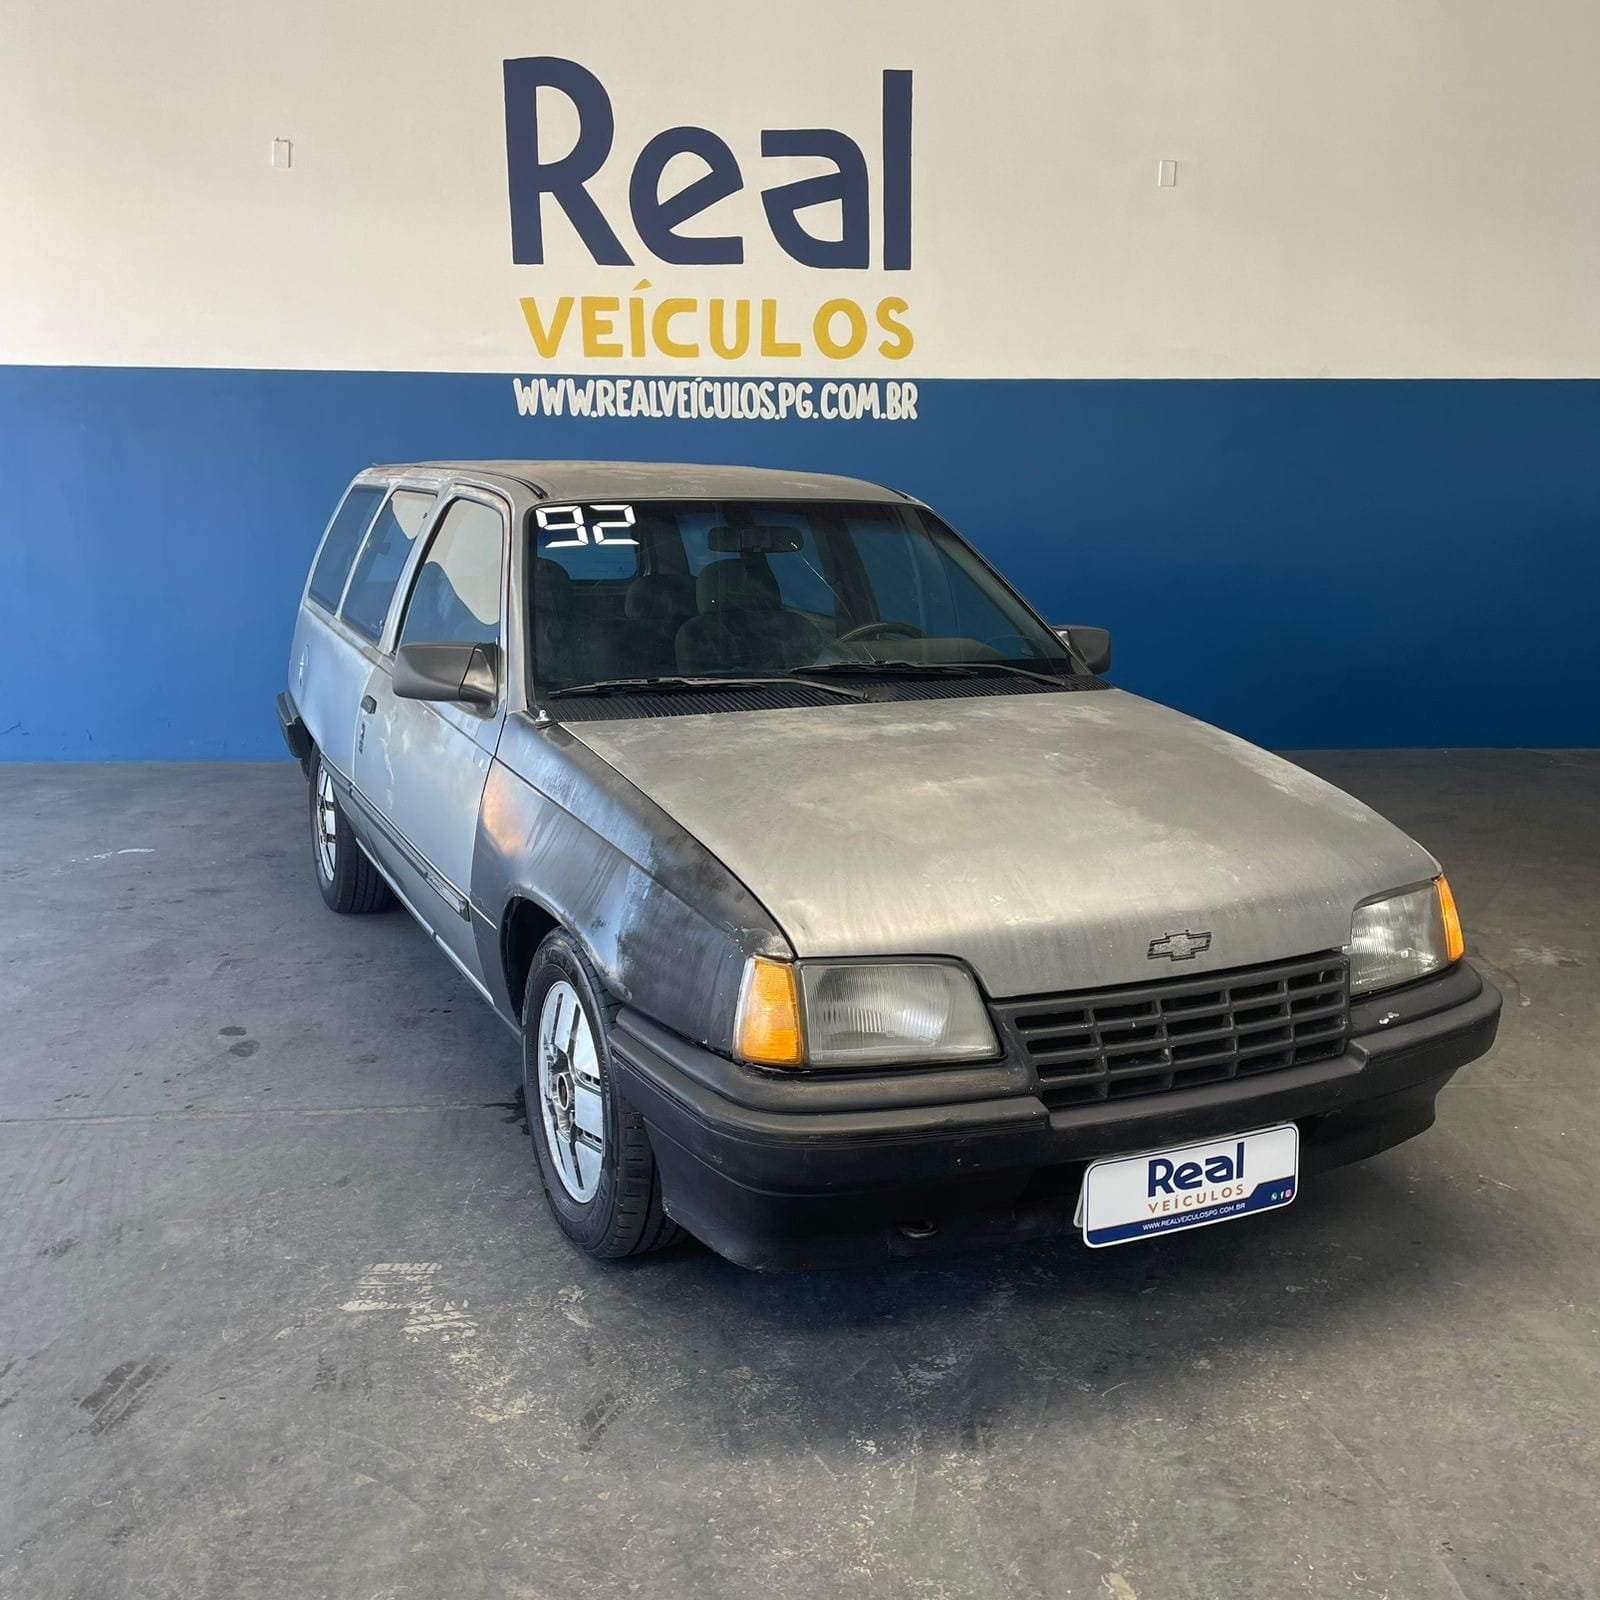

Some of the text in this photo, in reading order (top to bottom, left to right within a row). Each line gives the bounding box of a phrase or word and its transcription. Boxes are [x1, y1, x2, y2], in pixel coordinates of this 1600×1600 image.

[503, 56, 913, 270] Real
[519, 278, 914, 361] VEÍCULOS
[513, 377, 918, 420] WWW.REALVEÍCULOS.PG.COM.BR
[535, 504, 640, 548] 92
[1148, 1142, 1244, 1197] Real
[1148, 1184, 1244, 1214] VEÍCULOS
